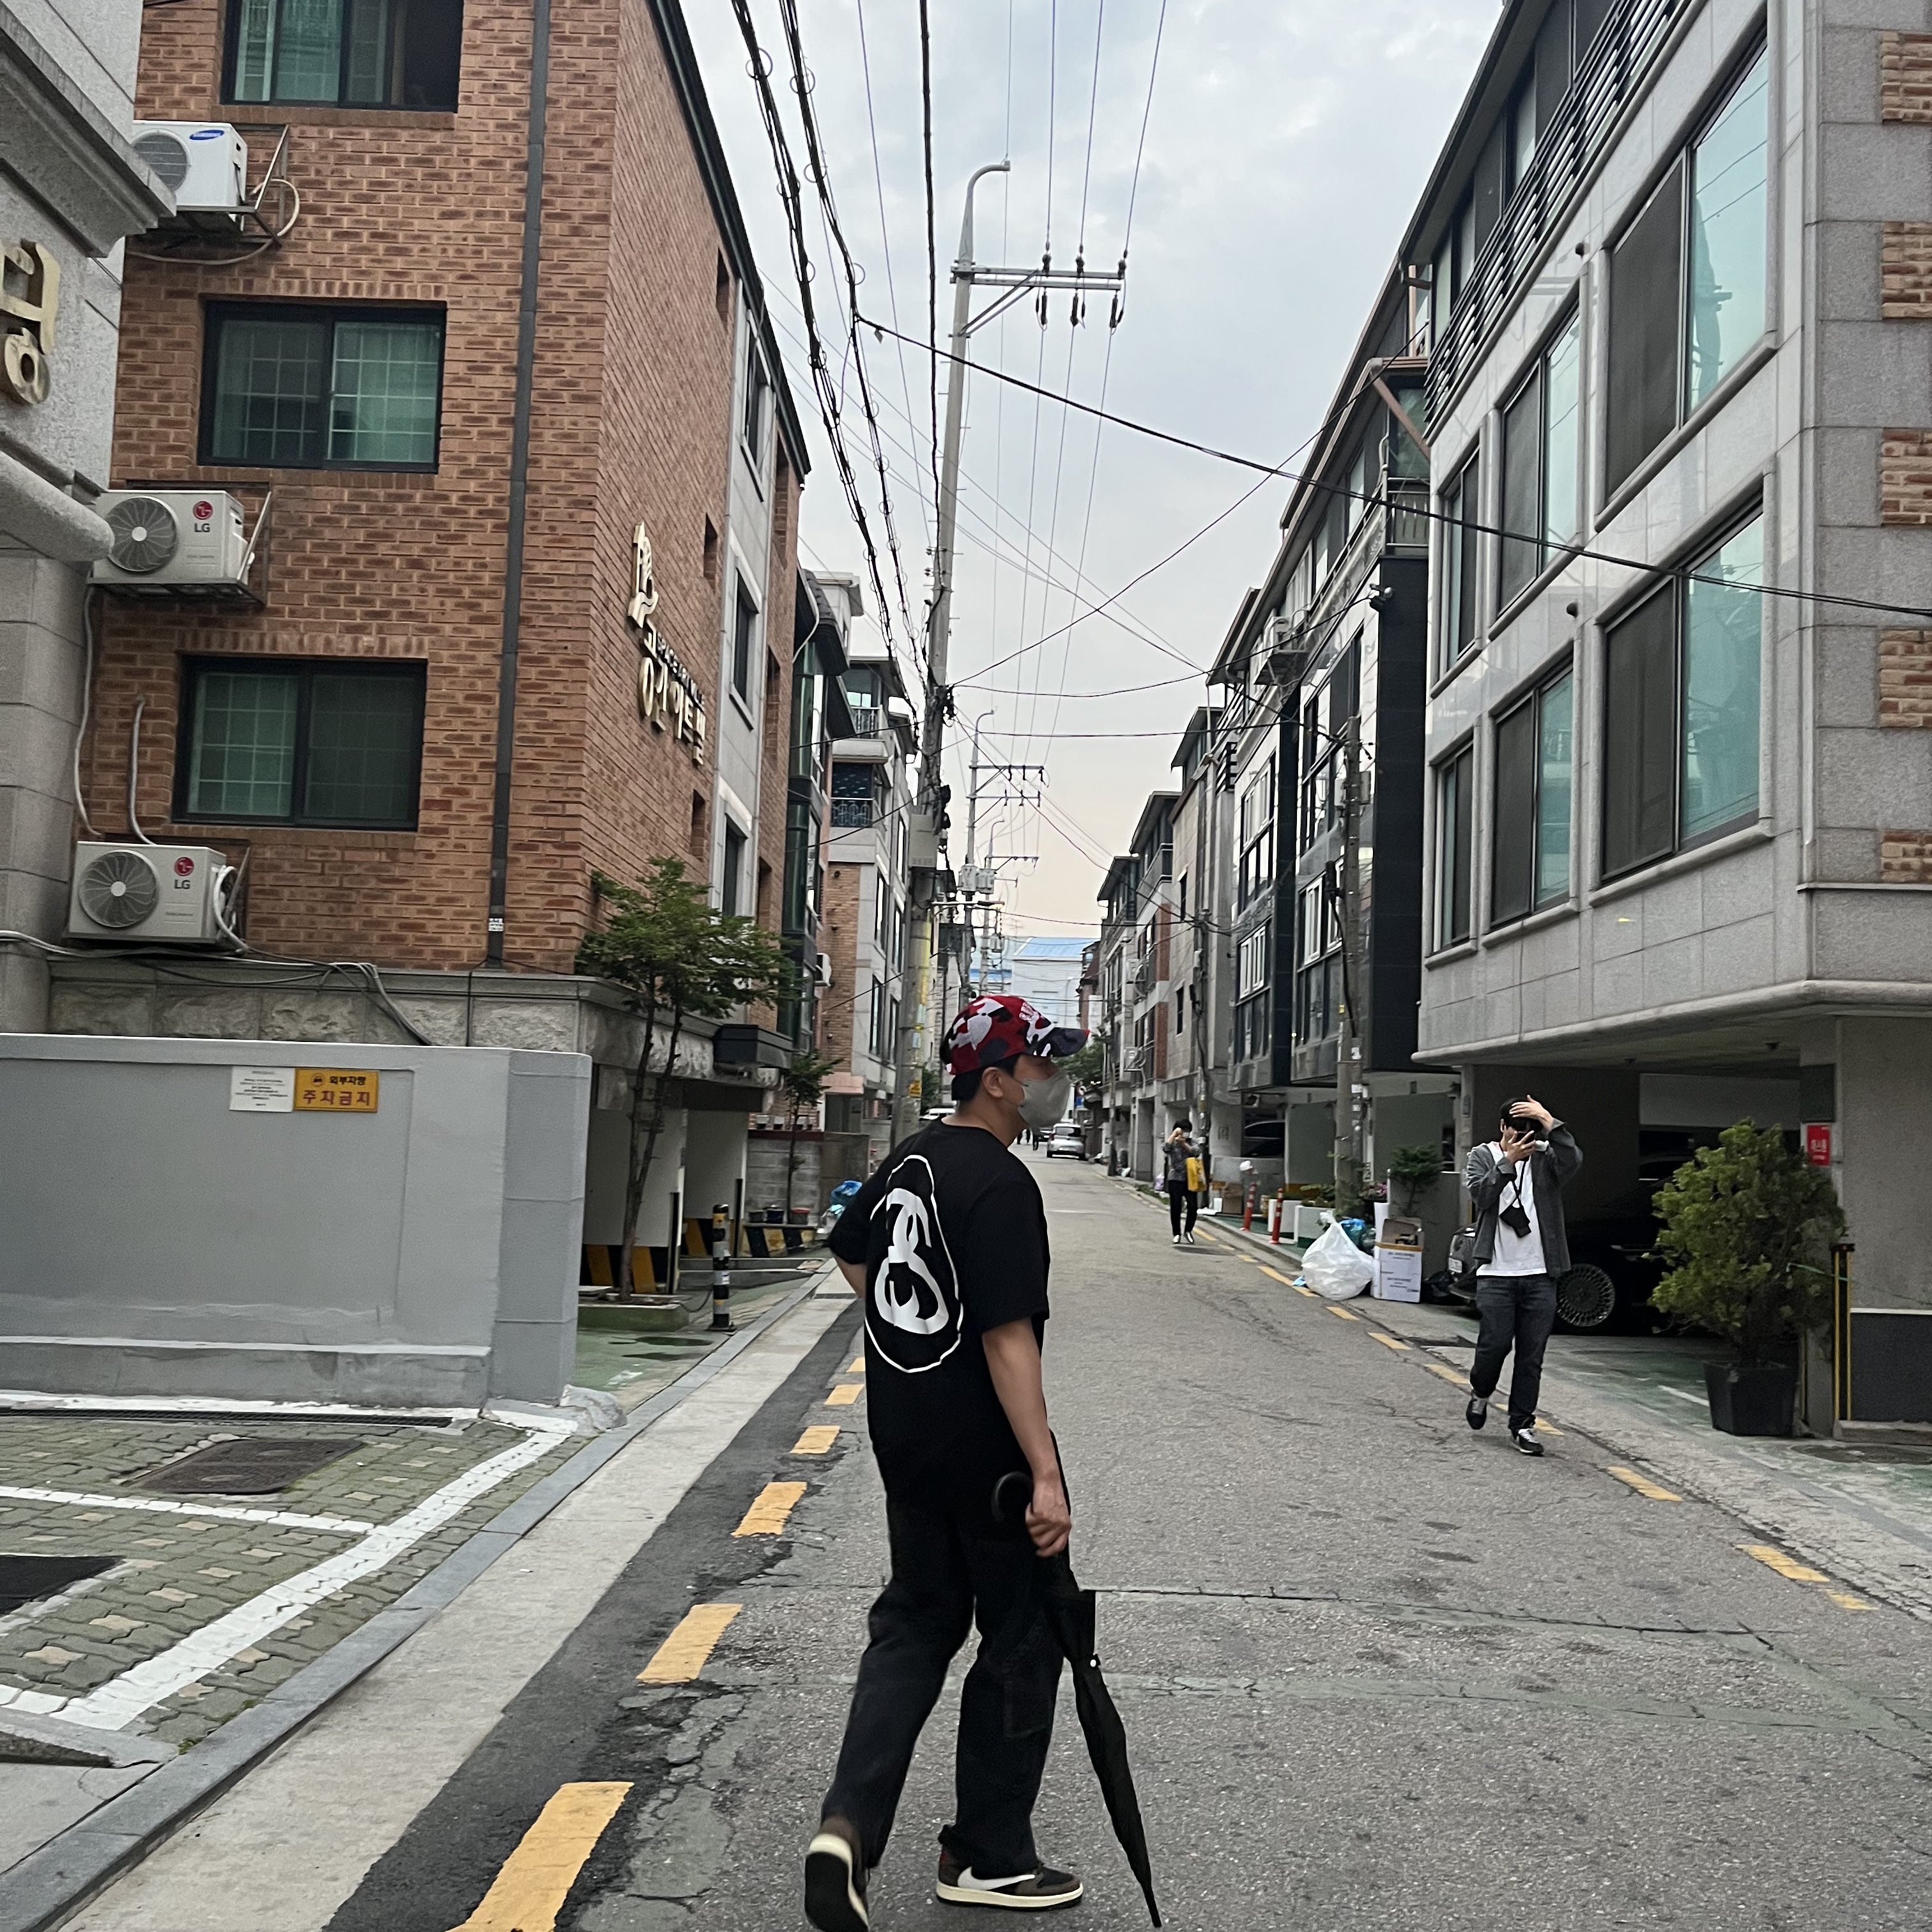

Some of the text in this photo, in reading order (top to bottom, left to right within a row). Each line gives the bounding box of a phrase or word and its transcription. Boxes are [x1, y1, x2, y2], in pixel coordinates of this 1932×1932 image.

[194, 523, 210, 533] LG
[174, 879, 190, 889] LG
[303, 1089, 370, 1106] 주차금지
